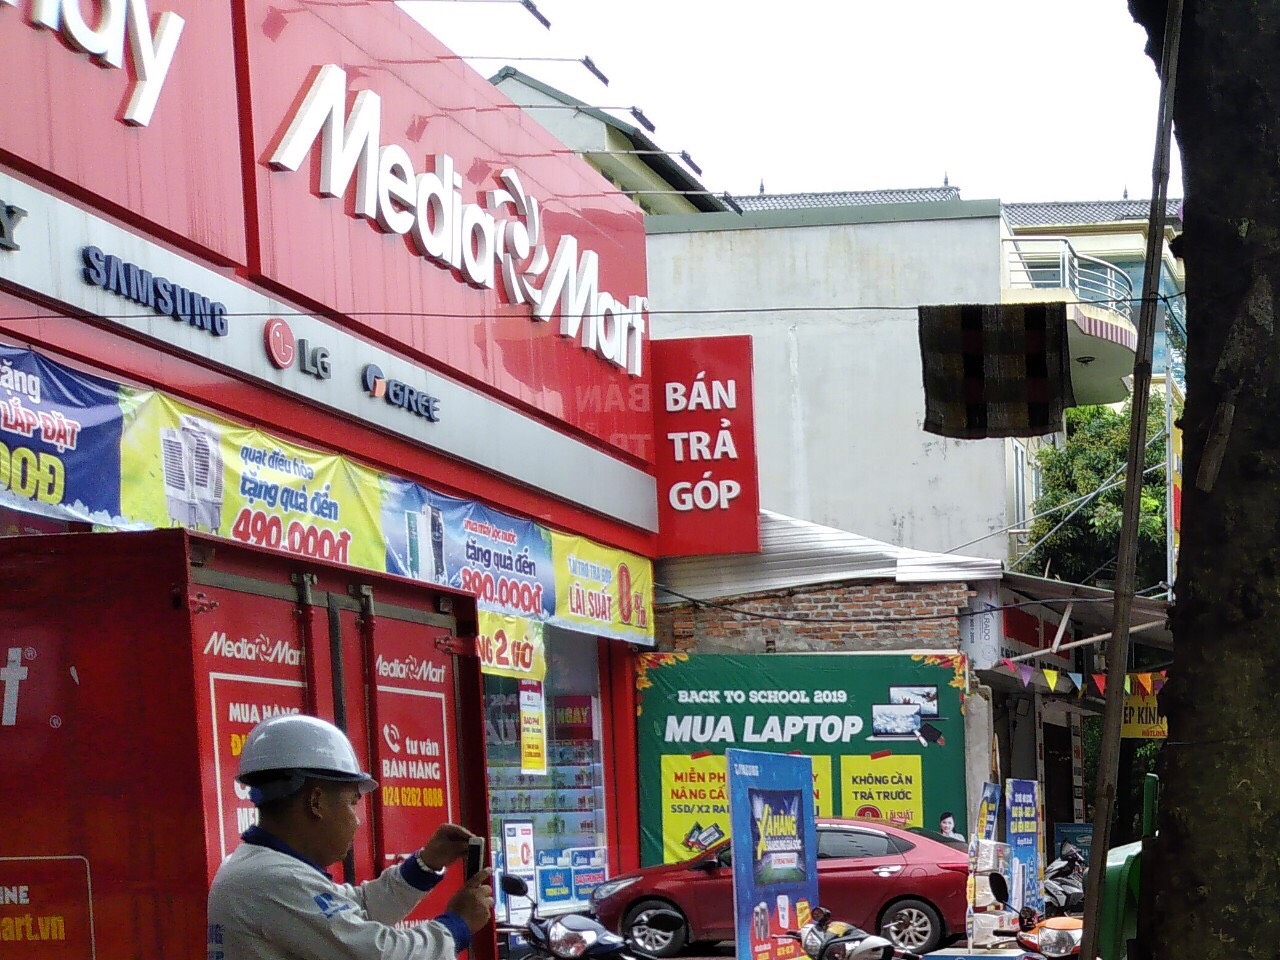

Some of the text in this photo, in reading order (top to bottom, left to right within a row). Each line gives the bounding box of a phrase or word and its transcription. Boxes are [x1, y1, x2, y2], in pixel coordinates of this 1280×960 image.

[268, 63, 645, 378] Media Mart
[82, 245, 229, 336] SAMSUNG
[299, 338, 332, 380] LG
[0, 359, 41, 404] ặng
[386, 379, 440, 422] GREE
[665, 370, 737, 412] BÁN
[38, 410, 82, 453] ĐẶT
[667, 418, 738, 462] TRẢ
[240, 445, 314, 480] quạt điều hòa
[240, 471, 339, 521] tặng quà đến
[669, 471, 741, 511] GÓP
[232, 508, 351, 564] 490.000đ
[466, 538, 536, 577] tặng quà đến
[460, 568, 544, 615] 890.000đ
[569, 582, 586, 616] LÃI
[588, 585, 613, 622] SUẤT
[203, 631, 257, 661] Media
[494, 628, 510, 667] 2
[418, 659, 447, 683] Mart
[229, 702, 261, 724] MUA
[677, 689, 848, 704] BACK TO SCHOOL 2019
[664, 715, 863, 743] MUA LAPTOP
[409, 759, 441, 780] HÀNG
[673, 767, 726, 783] MIỄN PH
[852, 771, 913, 785] KHÔNG CẦN
[382, 787, 401, 806] 024
[401, 787, 422, 807] 6262
[670, 785, 726, 800] NÂNG CẤ
[852, 788, 912, 801] TRẢ TRƯỚC
